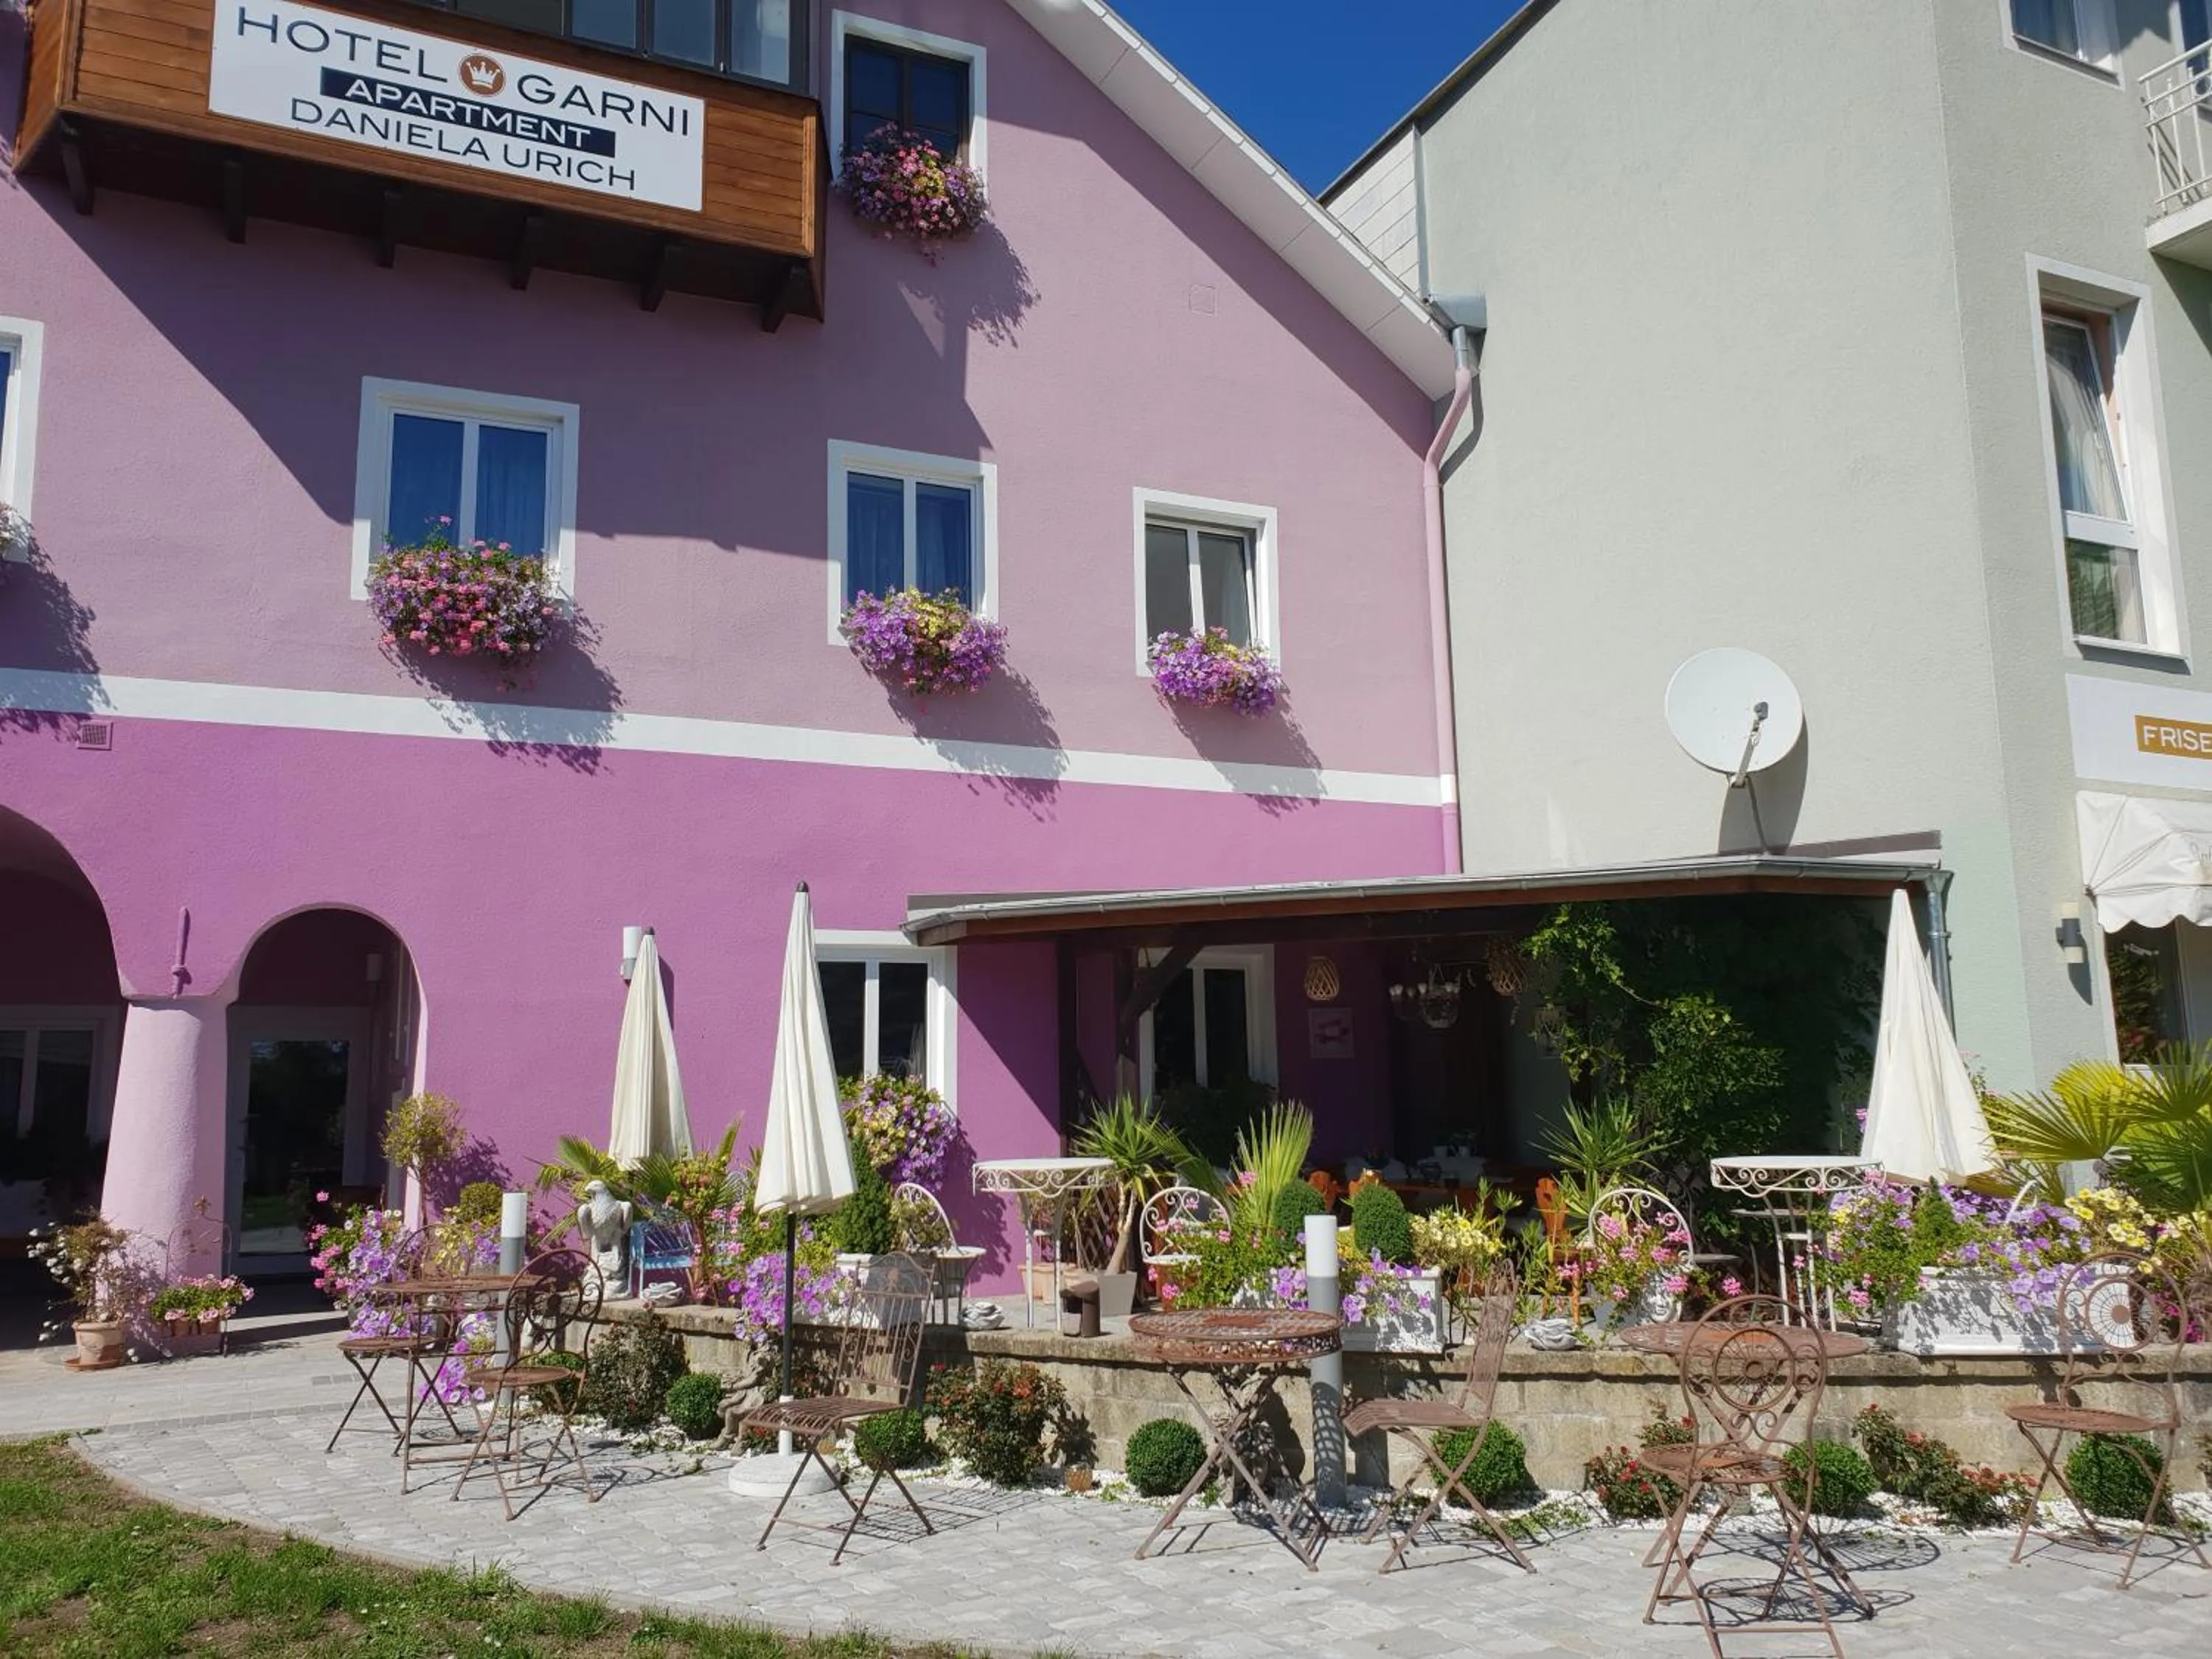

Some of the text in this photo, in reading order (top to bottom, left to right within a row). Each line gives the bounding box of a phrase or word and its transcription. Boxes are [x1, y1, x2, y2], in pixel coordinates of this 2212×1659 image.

[237, 7, 689, 136] HOTEL GARNI
[344, 78, 591, 148] APARTMENT
[291, 97, 636, 191] DANIELA URICH
